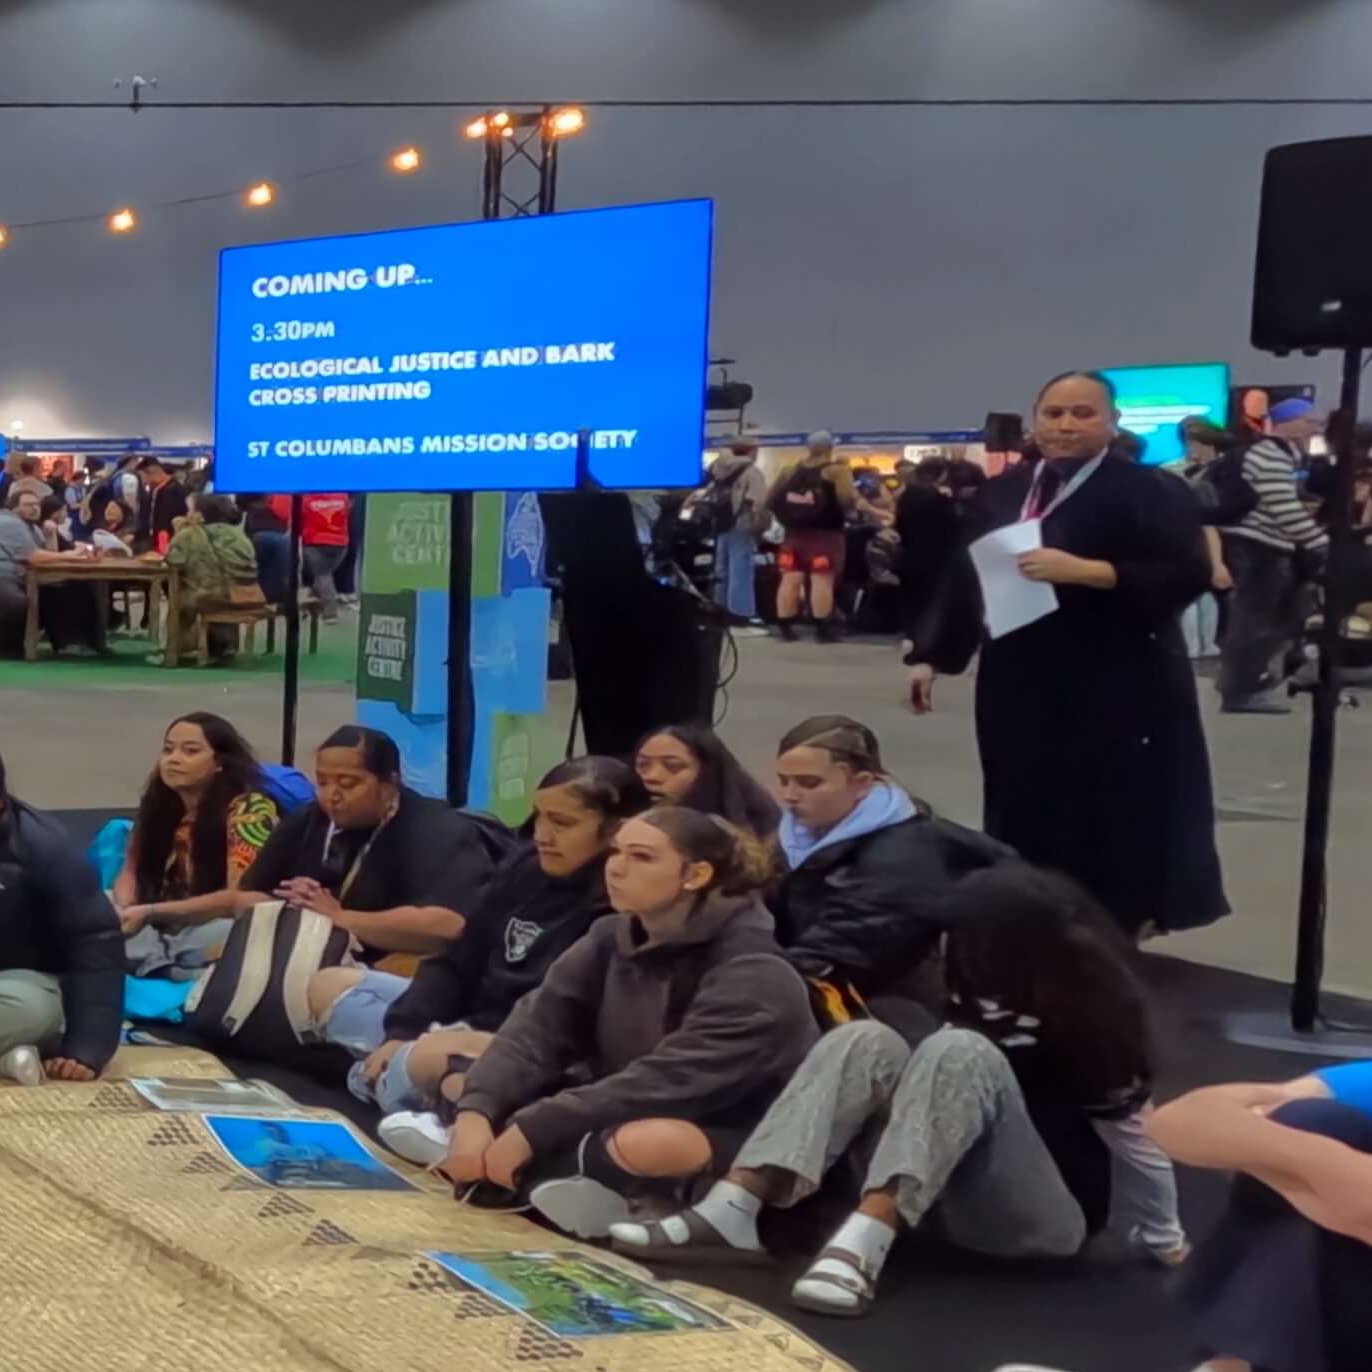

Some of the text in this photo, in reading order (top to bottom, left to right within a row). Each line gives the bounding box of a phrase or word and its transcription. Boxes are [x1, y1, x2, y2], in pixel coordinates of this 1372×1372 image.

[251, 263, 433, 298] COMING UP...
[250, 320, 336, 342] 3.30PM
[249, 341, 615, 380] ECOLOGICAL JUSTICE AND BARK
[248, 380, 431, 406] CROSS PRINTING
[247, 441, 270, 458] ST
[274, 436, 415, 457] COLUMBANS
[419, 432, 527, 453] MISSION
